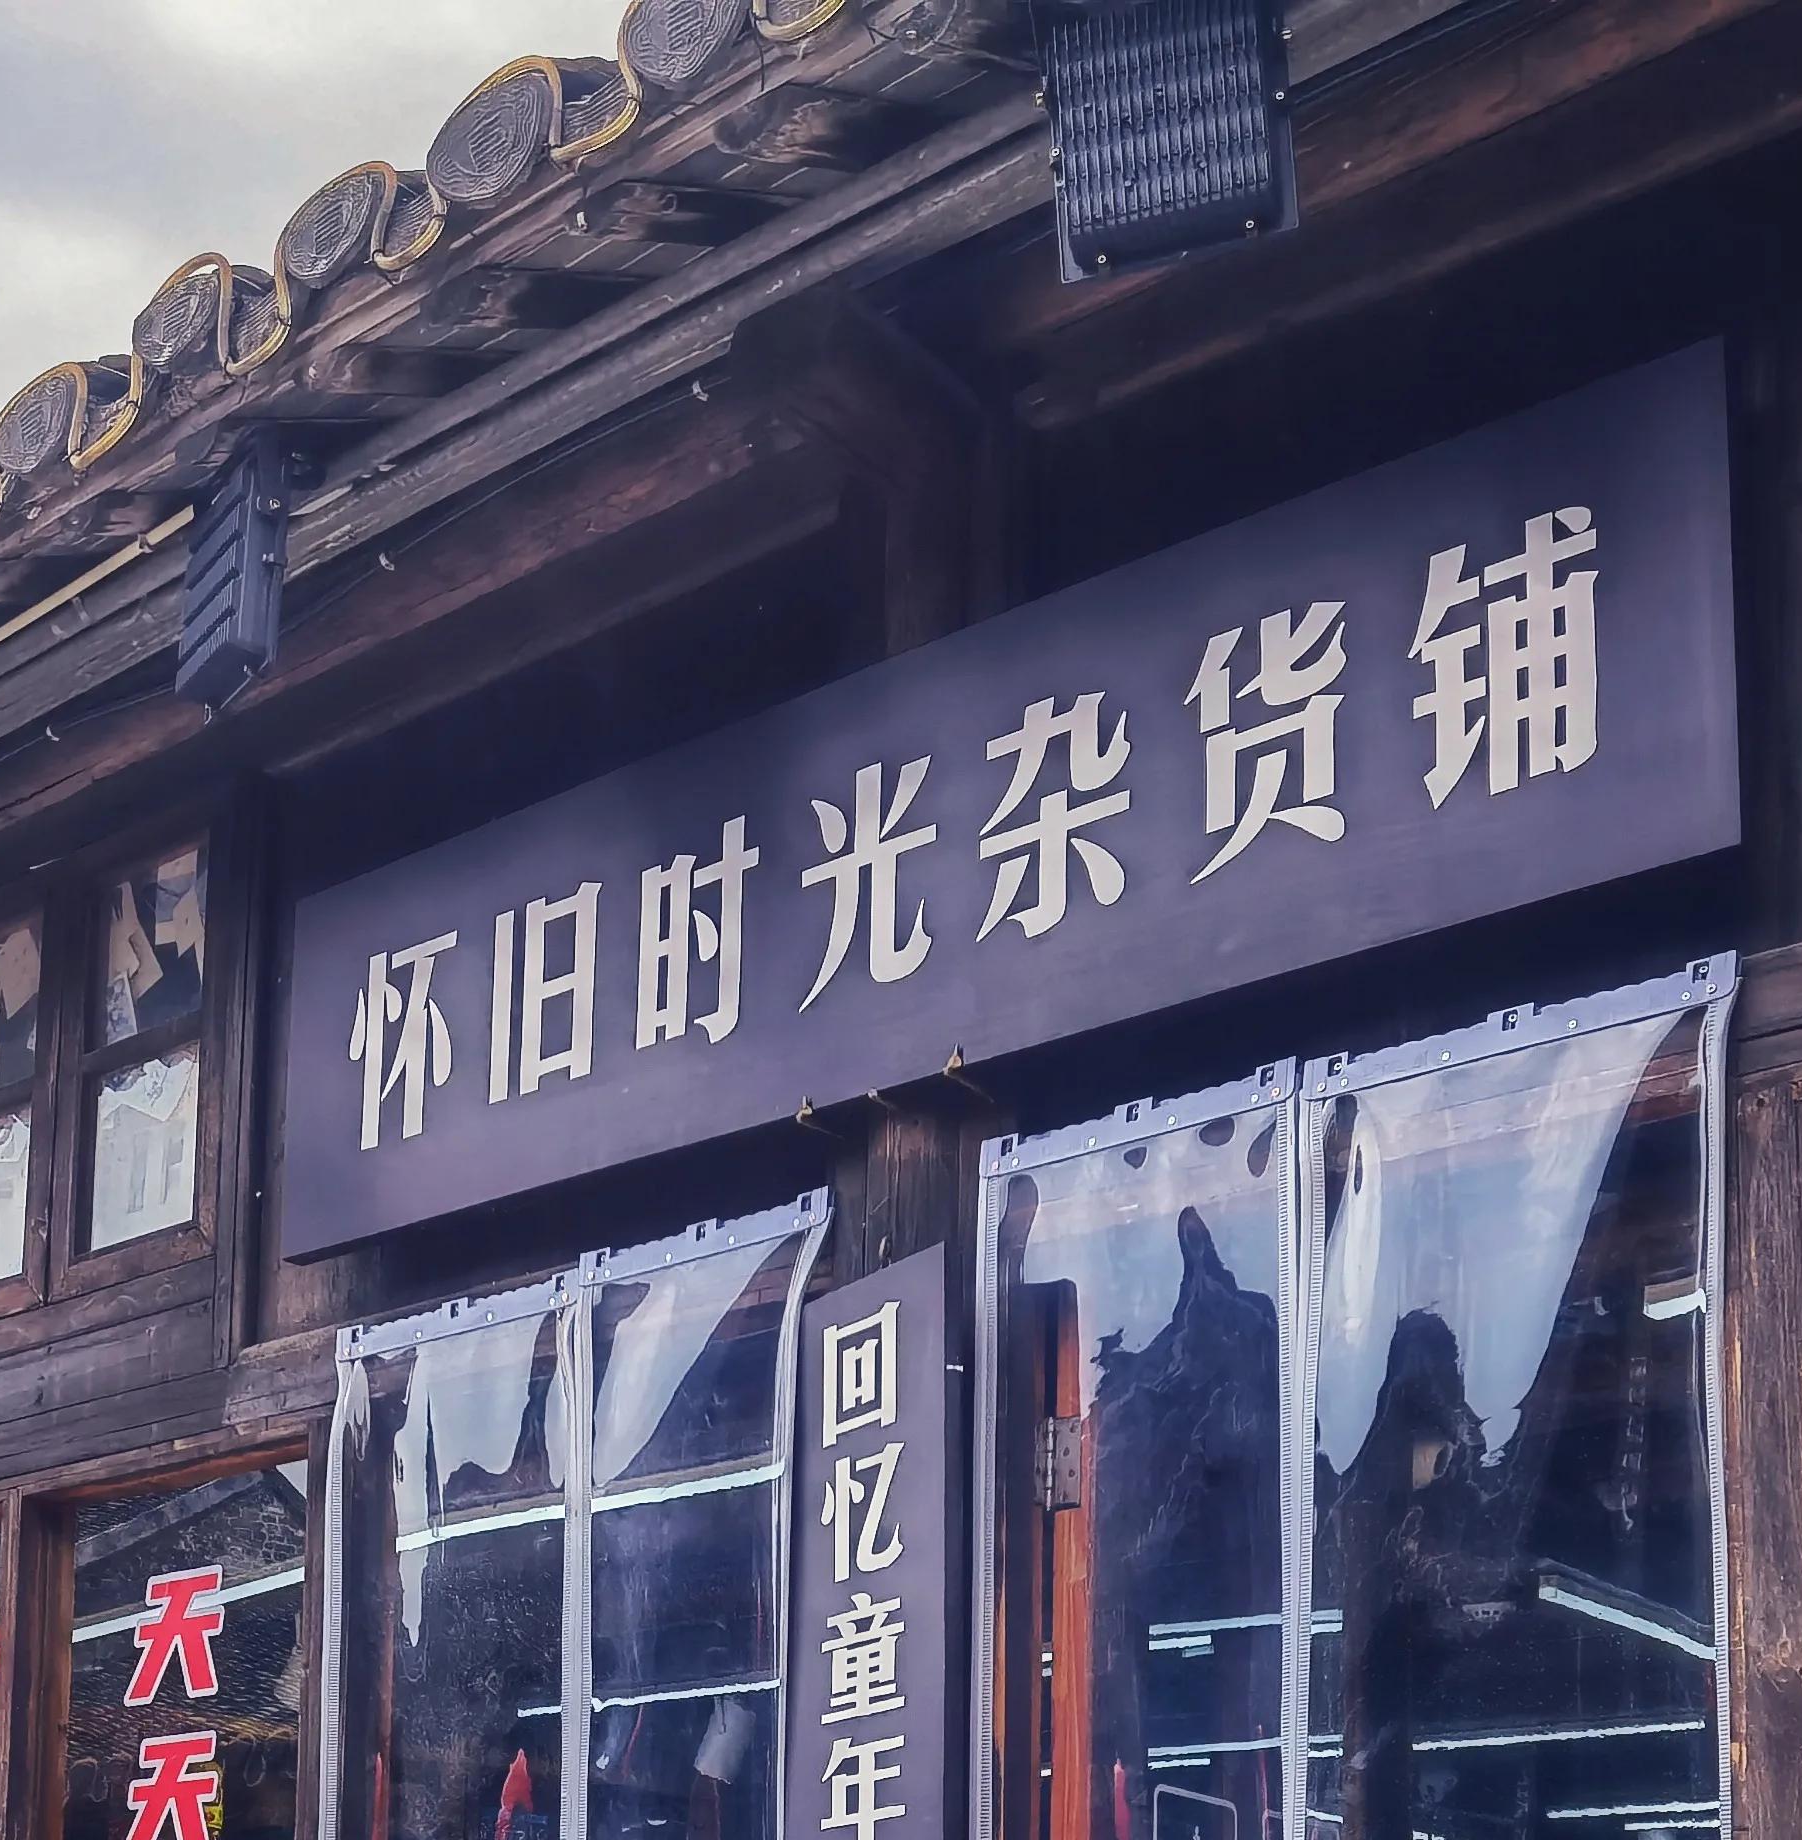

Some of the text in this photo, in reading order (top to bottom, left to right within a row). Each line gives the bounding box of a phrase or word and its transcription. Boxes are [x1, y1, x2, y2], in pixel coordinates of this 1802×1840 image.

[347, 505, 1601, 1151] 怀旧时光杂货铺
